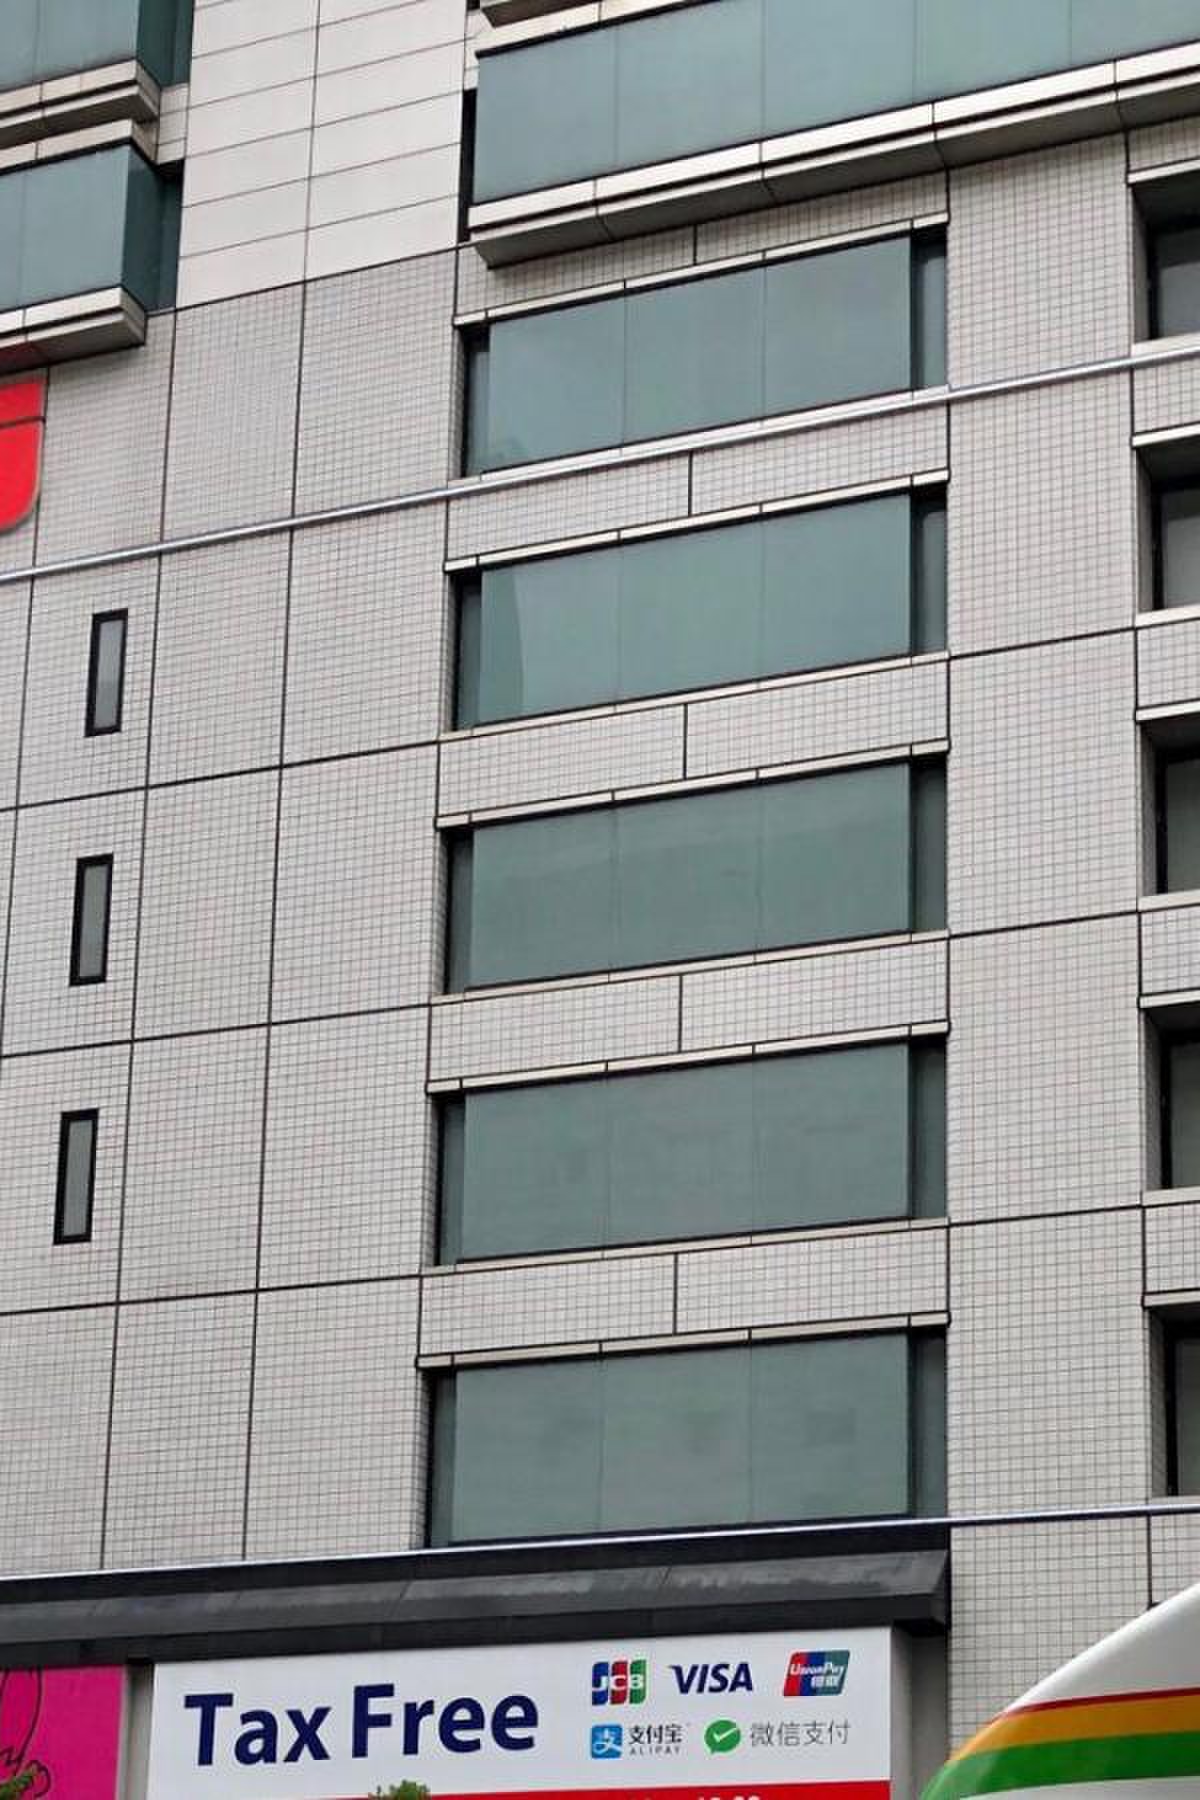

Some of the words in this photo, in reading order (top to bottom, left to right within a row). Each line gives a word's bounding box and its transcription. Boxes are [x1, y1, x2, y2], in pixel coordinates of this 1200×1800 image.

[669, 1661, 753, 1695] VISA
[184, 1692, 332, 1767] Tax
[351, 1683, 539, 1759] Free
[629, 1723, 682, 1745] 支付宝
[750, 1719, 851, 1747] 微信支付
